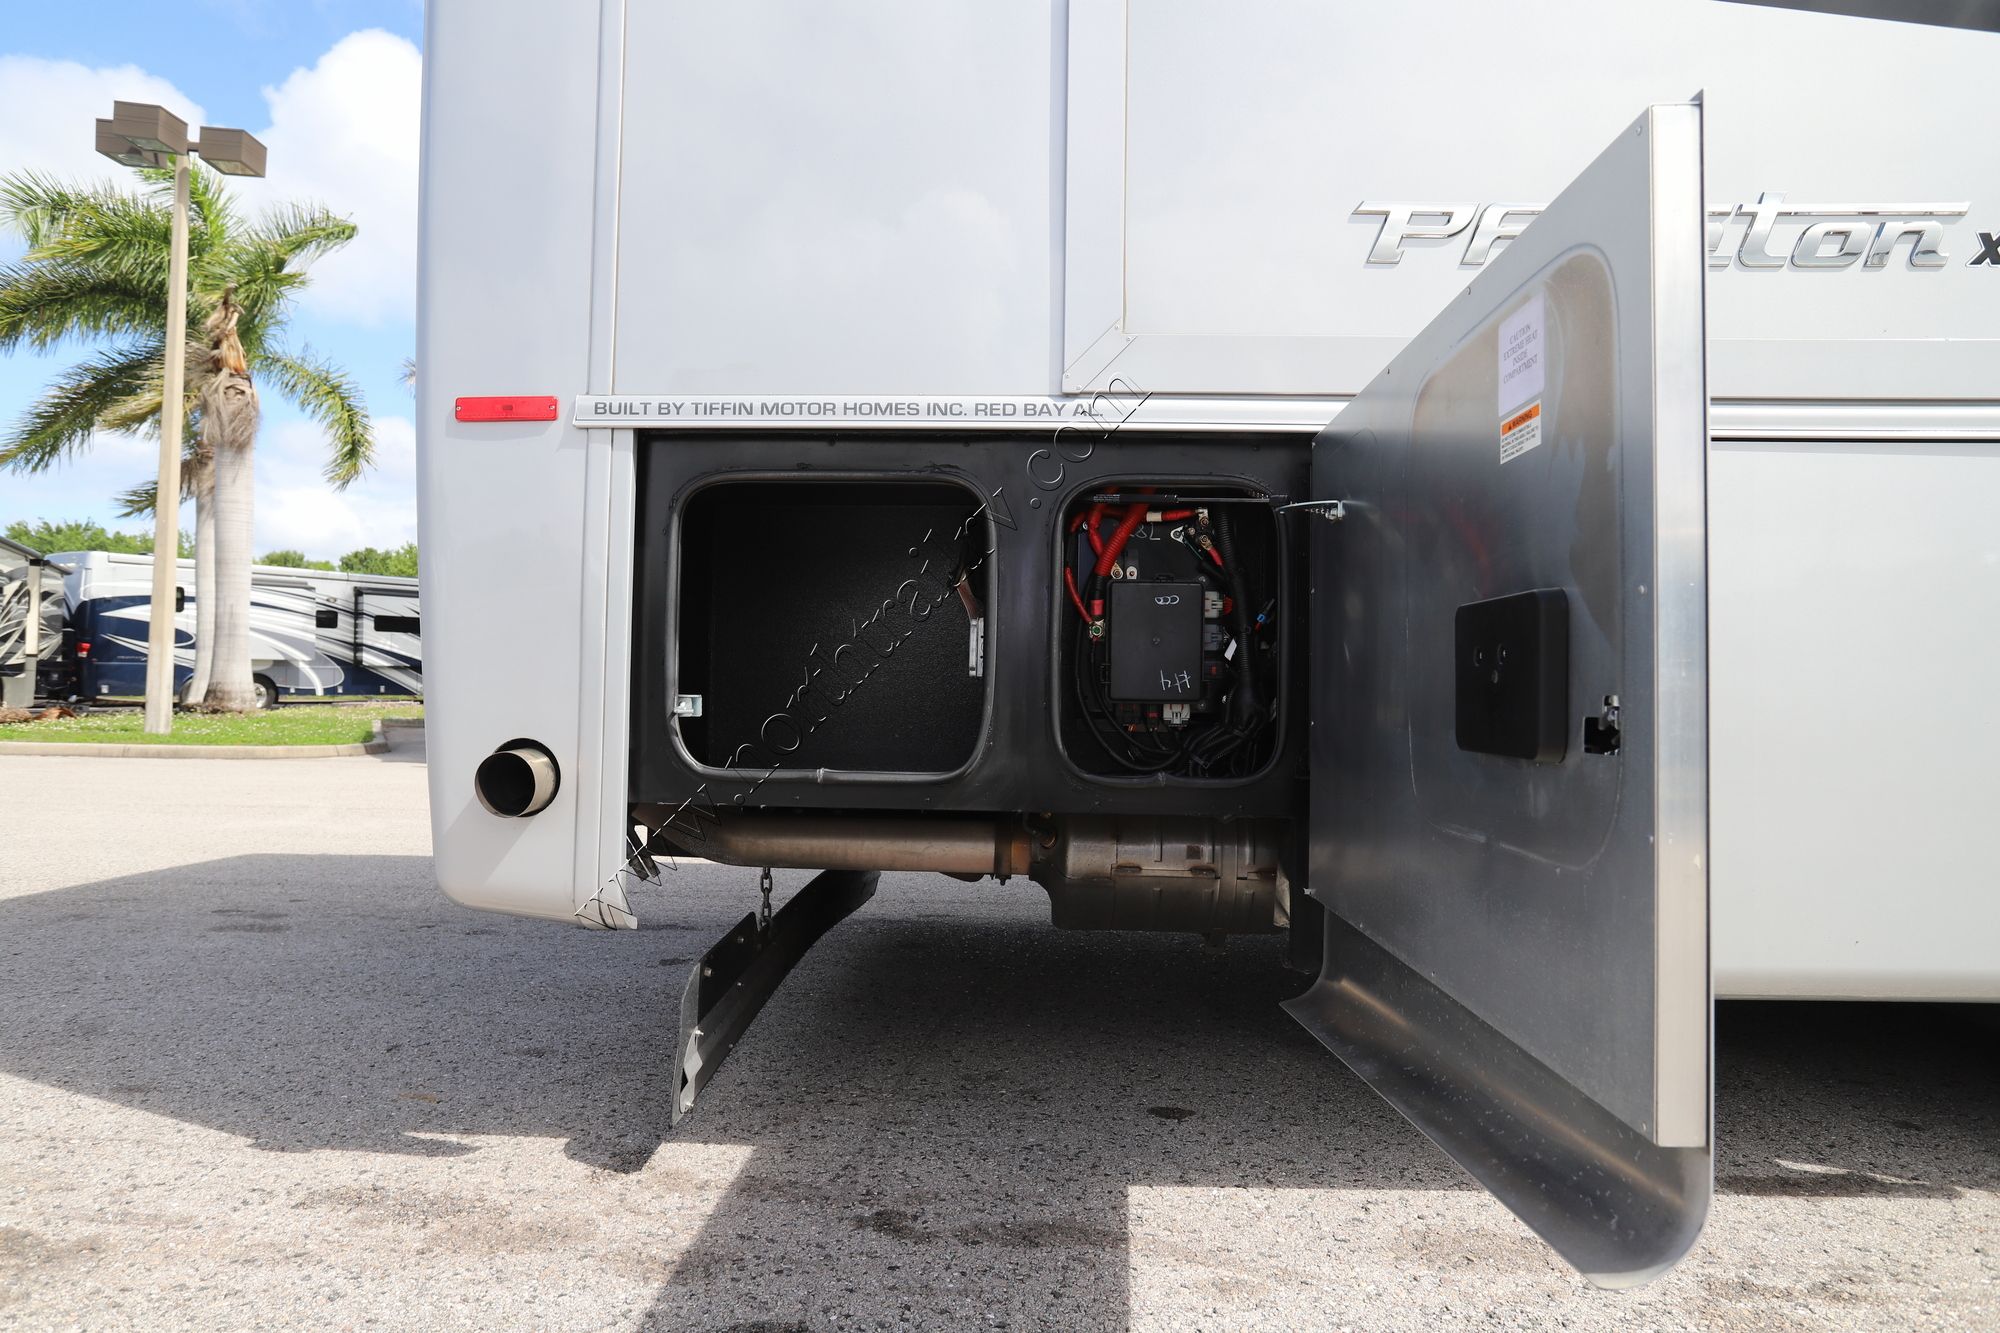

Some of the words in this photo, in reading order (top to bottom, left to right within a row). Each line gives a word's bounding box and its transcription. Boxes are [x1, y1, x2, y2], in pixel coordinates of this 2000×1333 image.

[1509, 324, 1531, 345] CAUTION
[1503, 338, 1524, 362] EXTREME
[1512, 348, 1529, 367] INSIDE
[1503, 353, 1539, 385] COMPARTMENT
[594, 402, 651, 416] BUILT
[657, 402, 684, 416] BY
[691, 402, 754, 416] TIFFIN
[760, 402, 836, 416] MOTOR
[843, 402, 920, 416] HOMES
[926, 403, 968, 417] INC.
[974, 403, 1017, 417] RED
[1023, 403, 1067, 417] BAY
